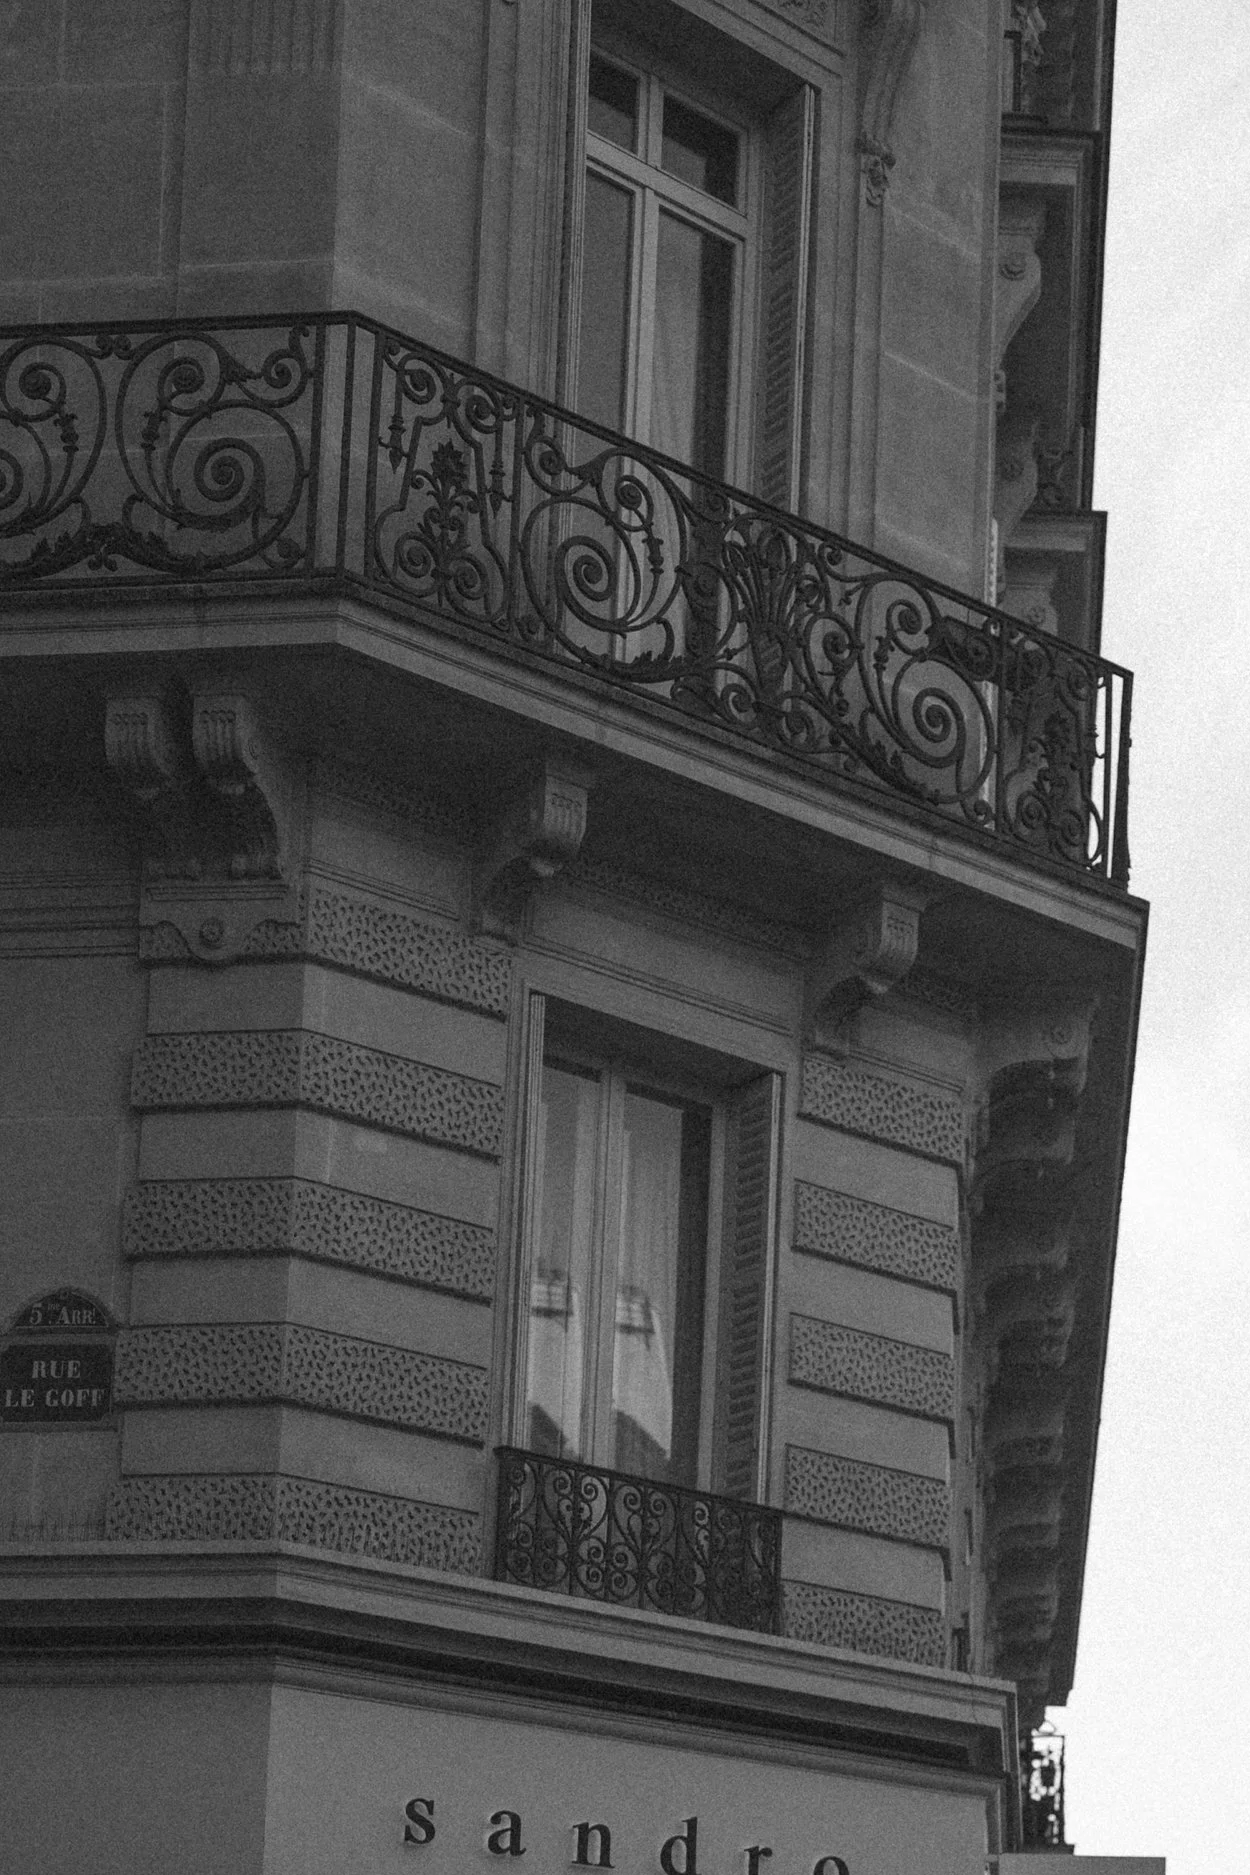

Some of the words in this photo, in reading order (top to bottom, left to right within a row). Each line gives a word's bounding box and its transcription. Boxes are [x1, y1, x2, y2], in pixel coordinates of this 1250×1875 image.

[31, 1360, 81, 1379] RUE
[4, 1389, 35, 1407] LE
[45, 1388, 105, 1407] GOFF
